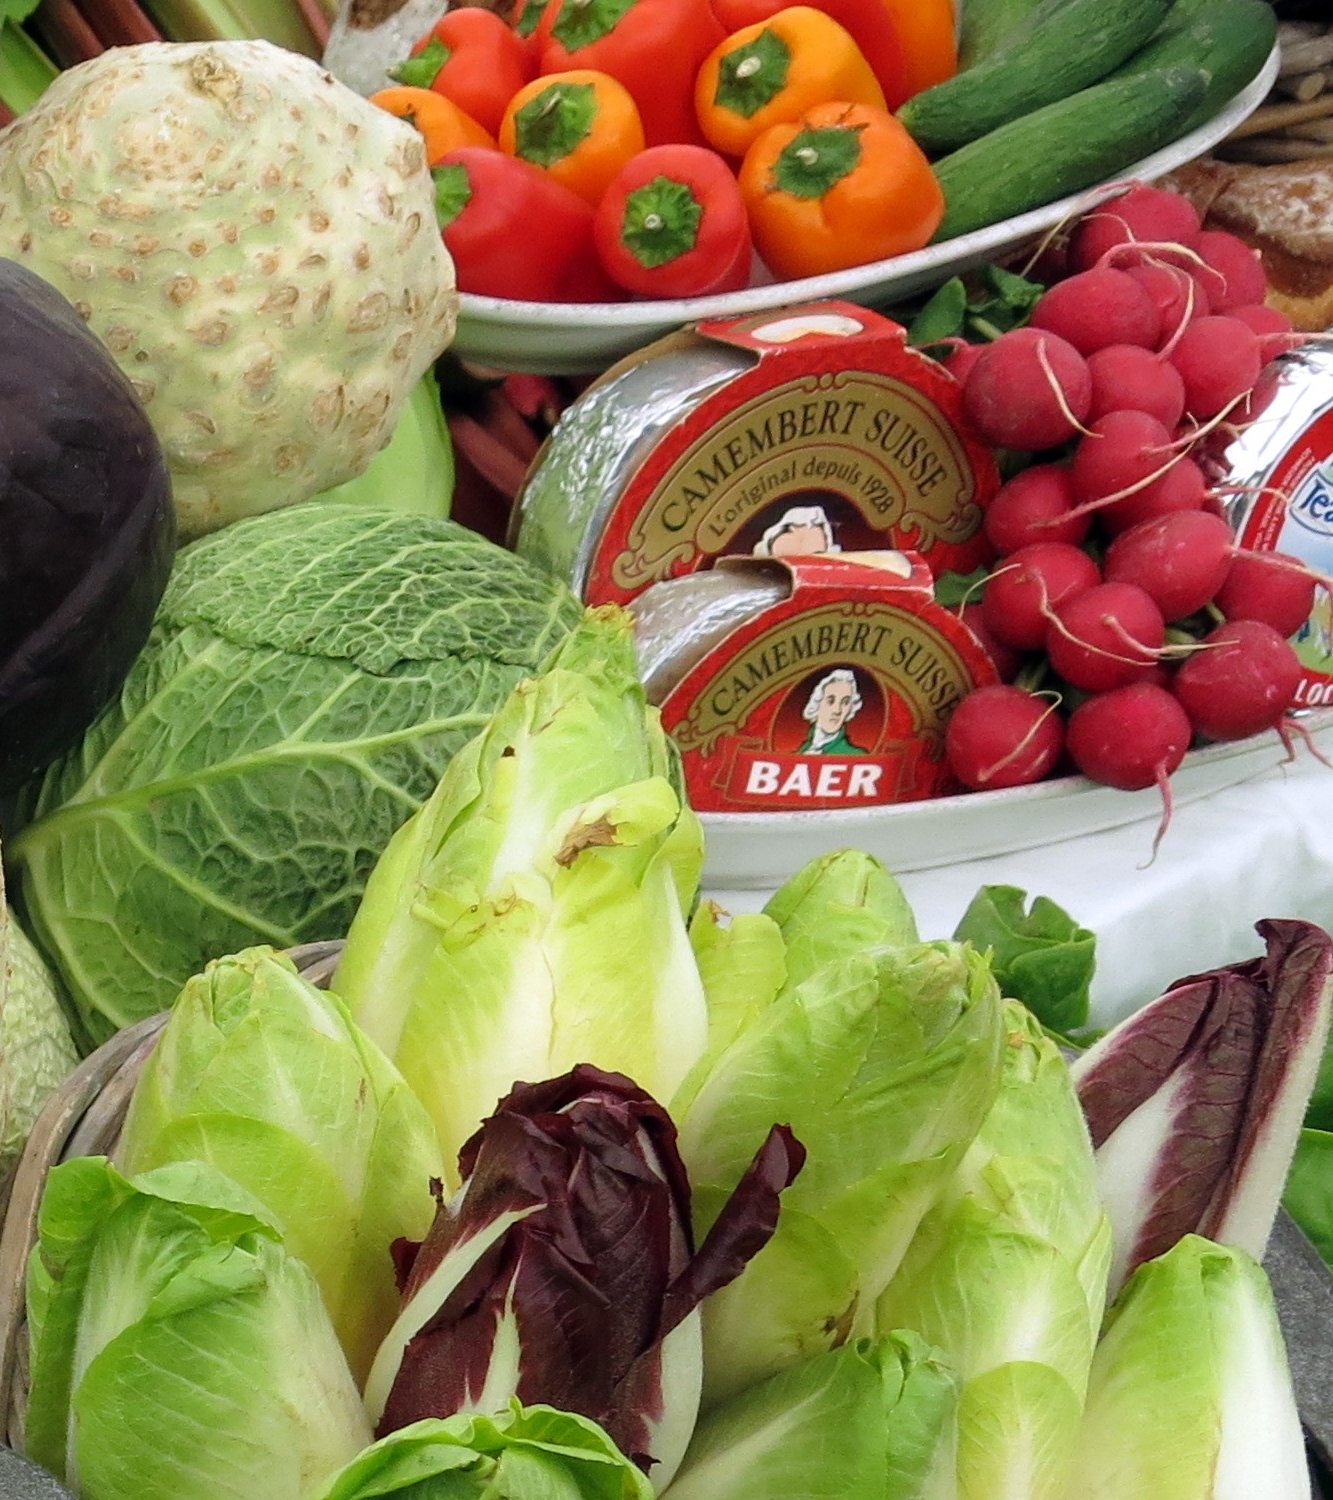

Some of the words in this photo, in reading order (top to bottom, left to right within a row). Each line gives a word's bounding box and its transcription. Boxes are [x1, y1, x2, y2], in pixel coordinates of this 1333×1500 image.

[661, 400, 866, 532] CAMEMBERT
[864, 407, 948, 498] SUISSE
[708, 460, 796, 537] L'original
[803, 456, 862, 486] depuis
[863, 472, 895, 515] 1928
[712, 622, 893, 717] CAMEMBERT
[744, 760, 883, 798] BAER
